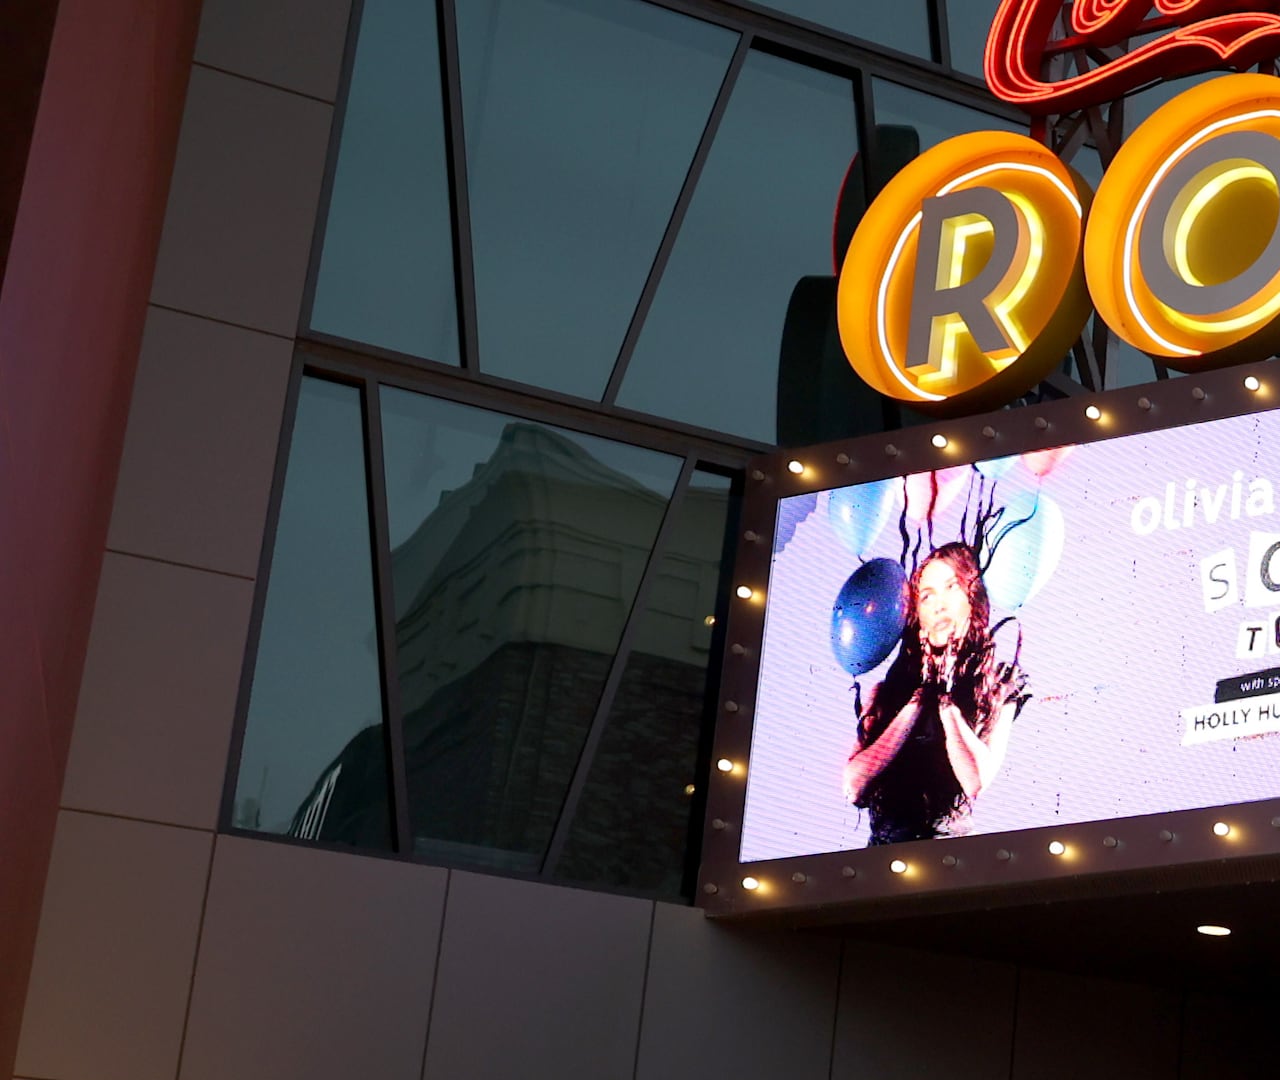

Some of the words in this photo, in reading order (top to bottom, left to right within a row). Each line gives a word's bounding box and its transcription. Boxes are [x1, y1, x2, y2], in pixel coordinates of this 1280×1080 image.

[1130, 469, 1275, 536] olivia
[1240, 676, 1265, 693] with
[1193, 708, 1252, 733] HOLLY
